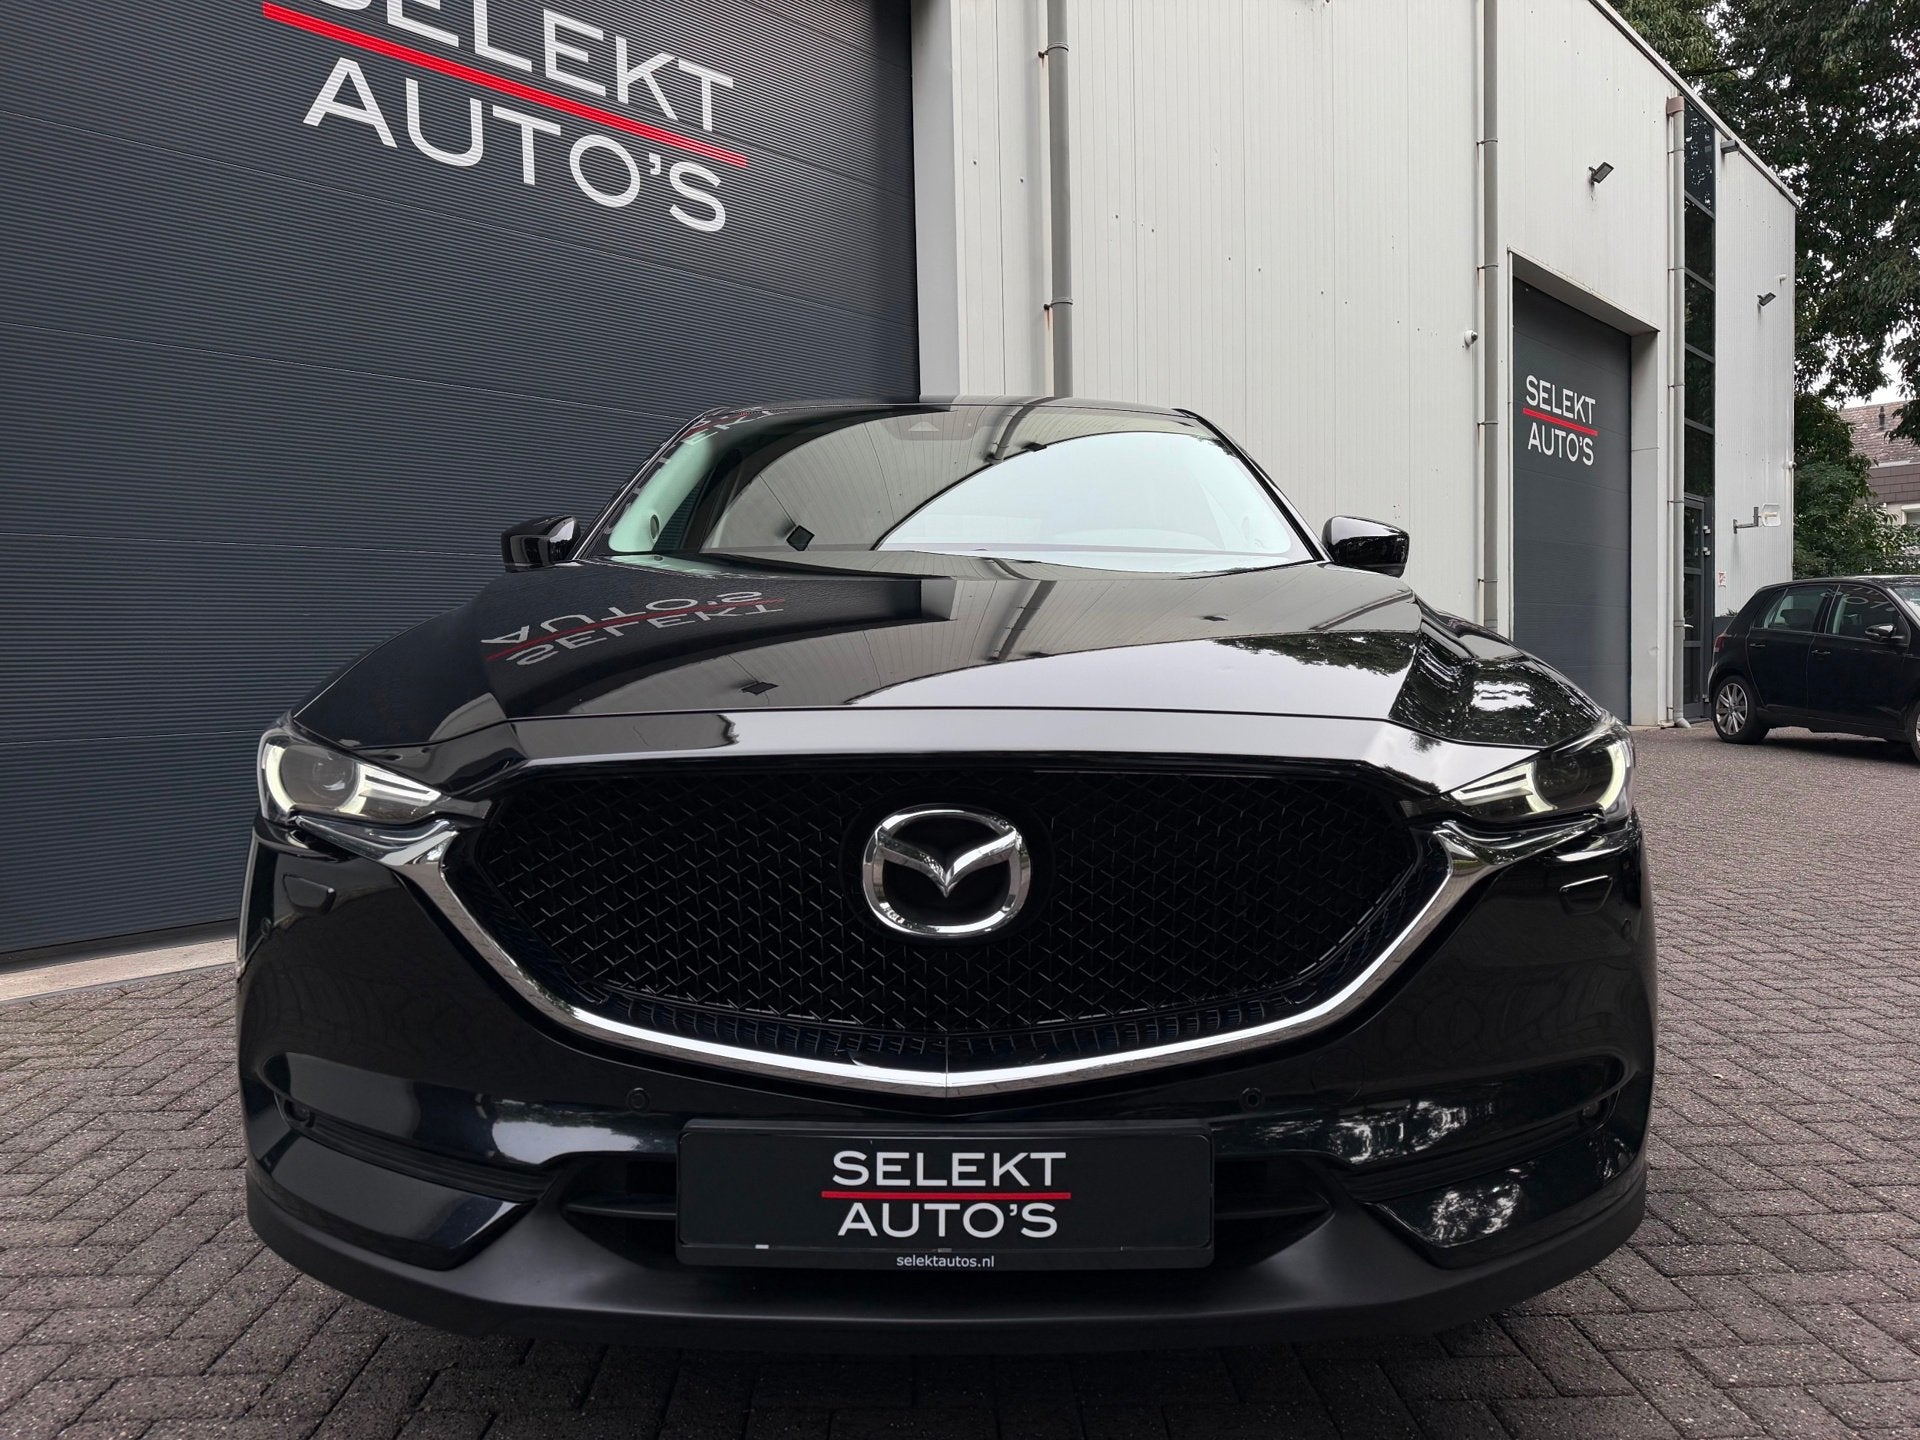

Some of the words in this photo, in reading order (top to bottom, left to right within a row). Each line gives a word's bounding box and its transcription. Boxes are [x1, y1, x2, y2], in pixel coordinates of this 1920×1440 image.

[313, 0, 734, 132] ELEKT
[303, 57, 726, 232] AUTO'S
[1526, 375, 1595, 424] SELEKT
[1528, 422, 1594, 466] AUTO'S
[833, 1150, 1067, 1187] SELEKT
[838, 1202, 1058, 1239] AUTO'S
[896, 1255, 995, 1268] selektautos.nl
